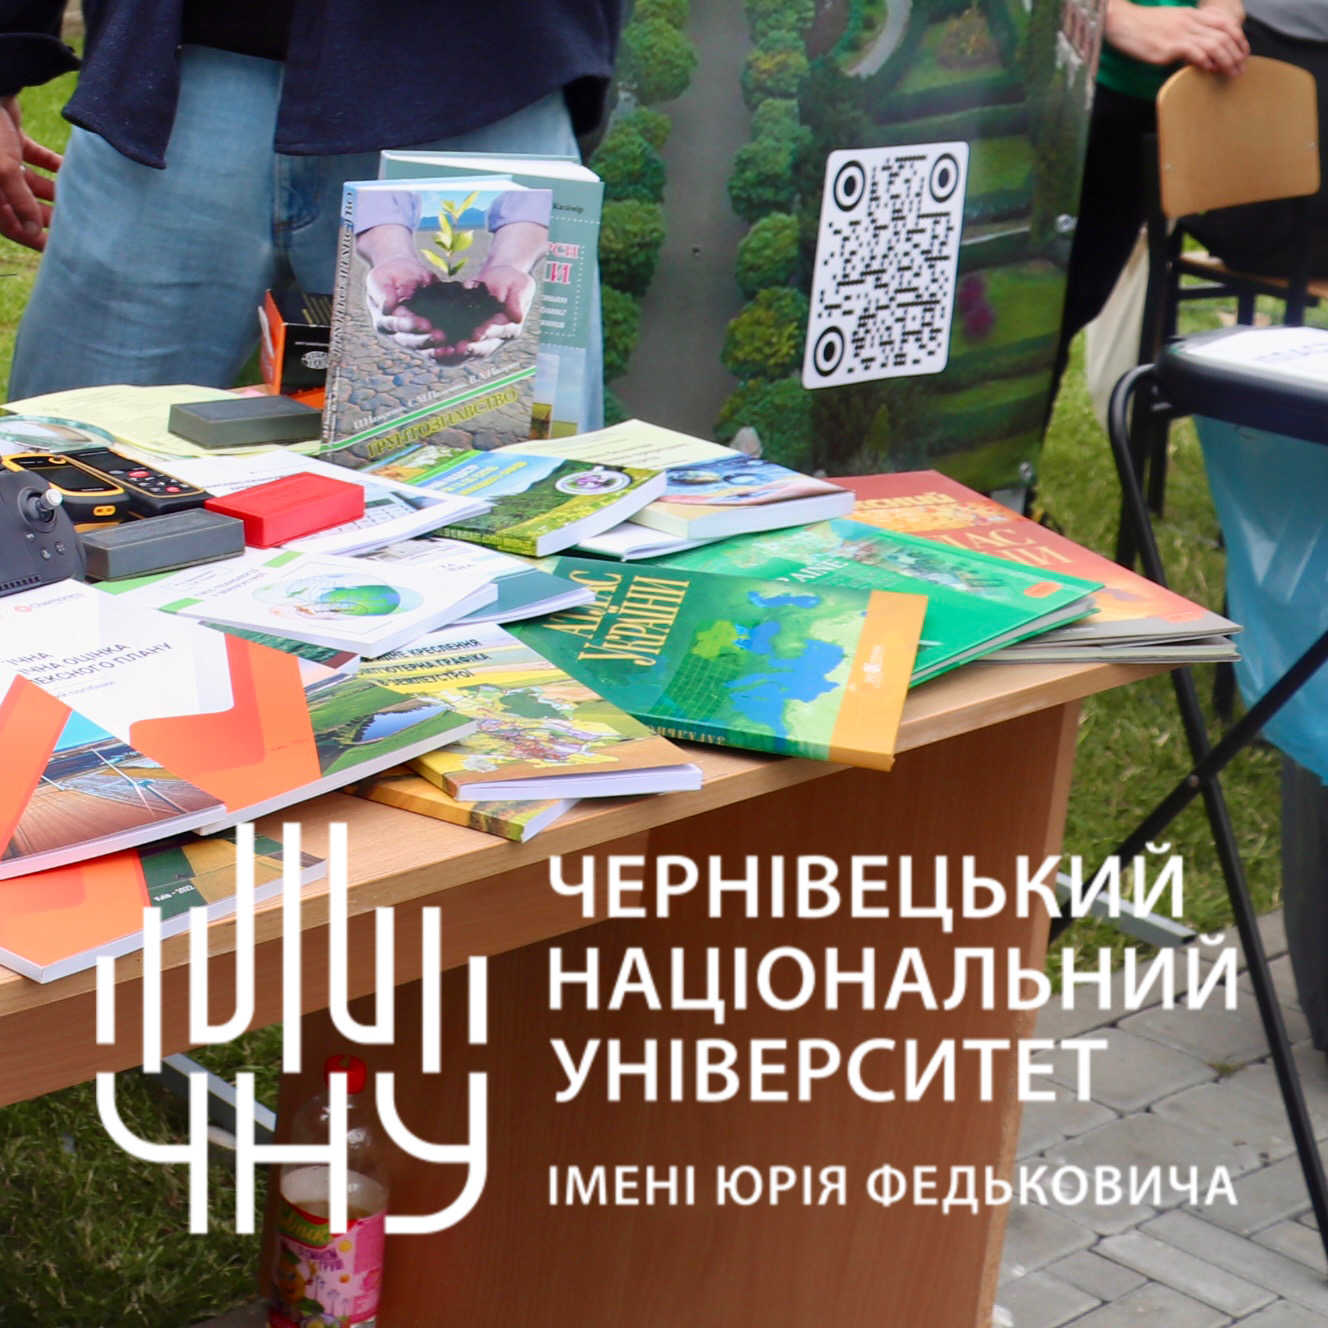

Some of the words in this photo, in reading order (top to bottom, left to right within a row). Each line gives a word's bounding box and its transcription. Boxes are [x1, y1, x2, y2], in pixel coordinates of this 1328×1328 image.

[577, 575, 691, 667] УКРАЇНИ
[62, 642, 132, 667] ОЦІНКА
[113, 641, 174, 667] ПЛАНУ
[436, 652, 493, 668] ГРАФІКА
